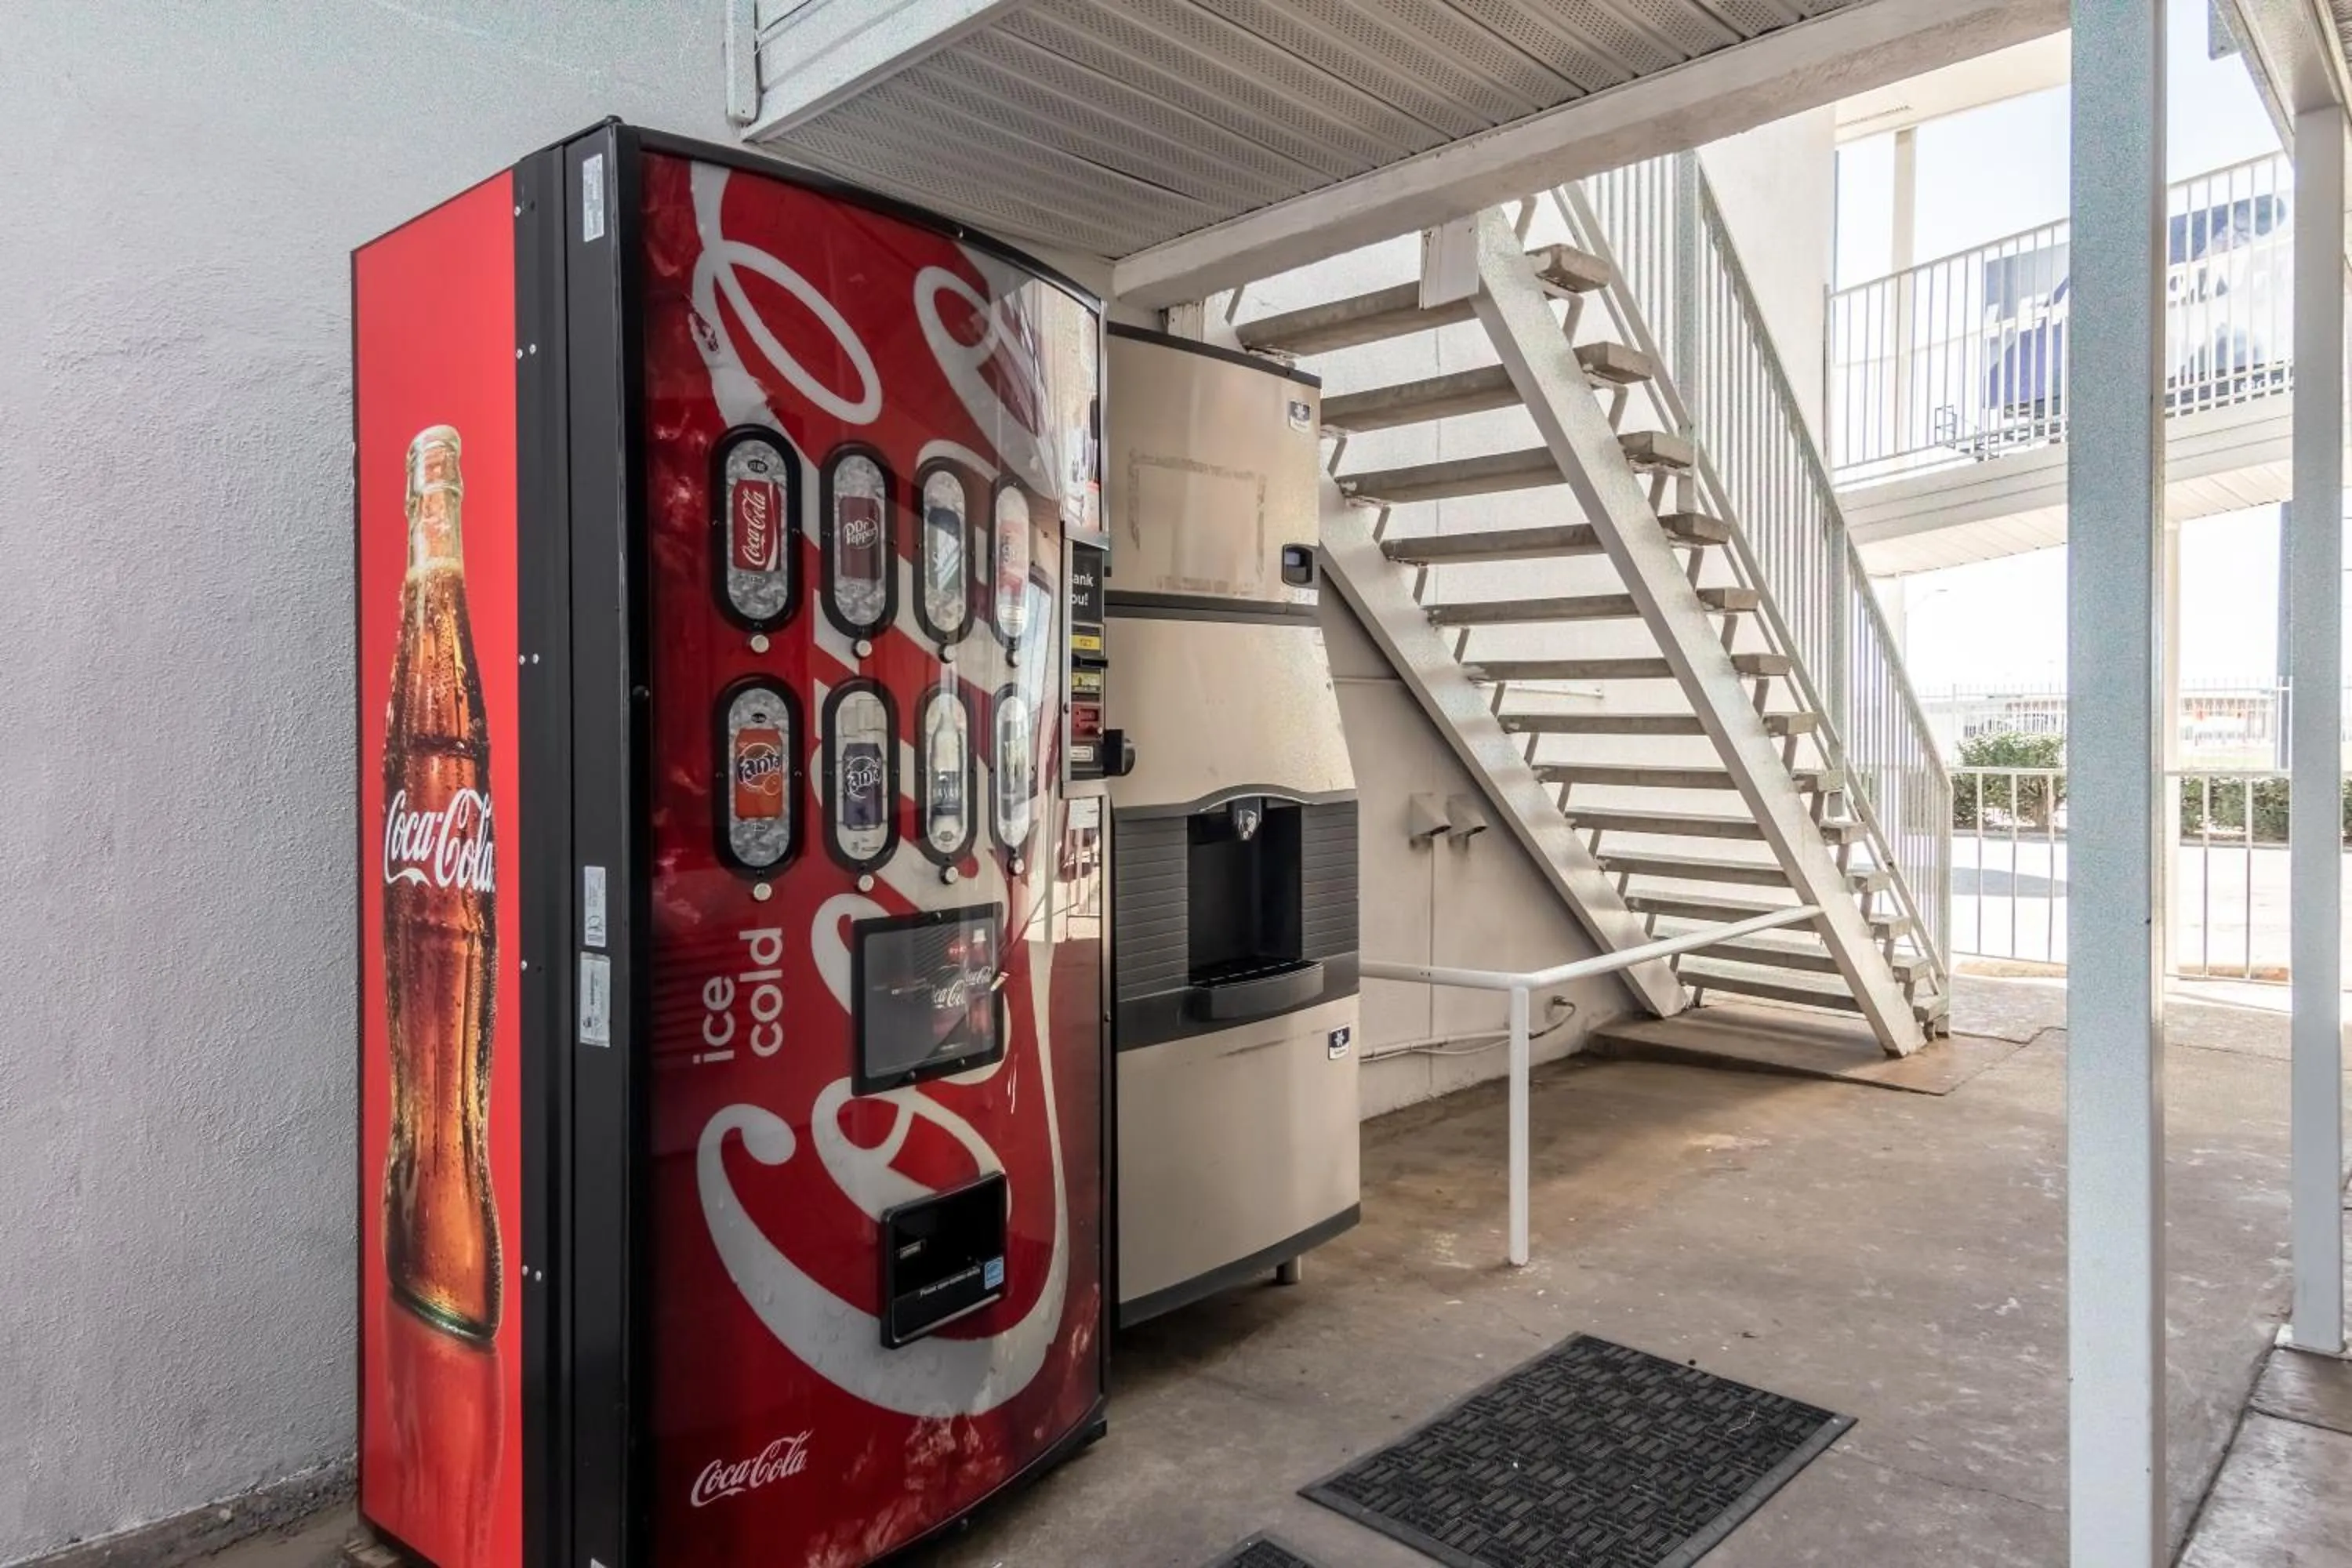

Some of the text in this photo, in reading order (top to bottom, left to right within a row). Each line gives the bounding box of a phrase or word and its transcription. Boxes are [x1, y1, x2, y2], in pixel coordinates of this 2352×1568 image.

[742, 486, 767, 566] Coca-Cola
[845, 523, 878, 546] Pepper
[1070, 593, 1089, 606] ou!
[384, 788, 495, 893] Coca-Cola
[692, 976, 735, 1065] ice
[739, 927, 783, 1058] cold
[690, 1428, 815, 1508] Coca-Cola
